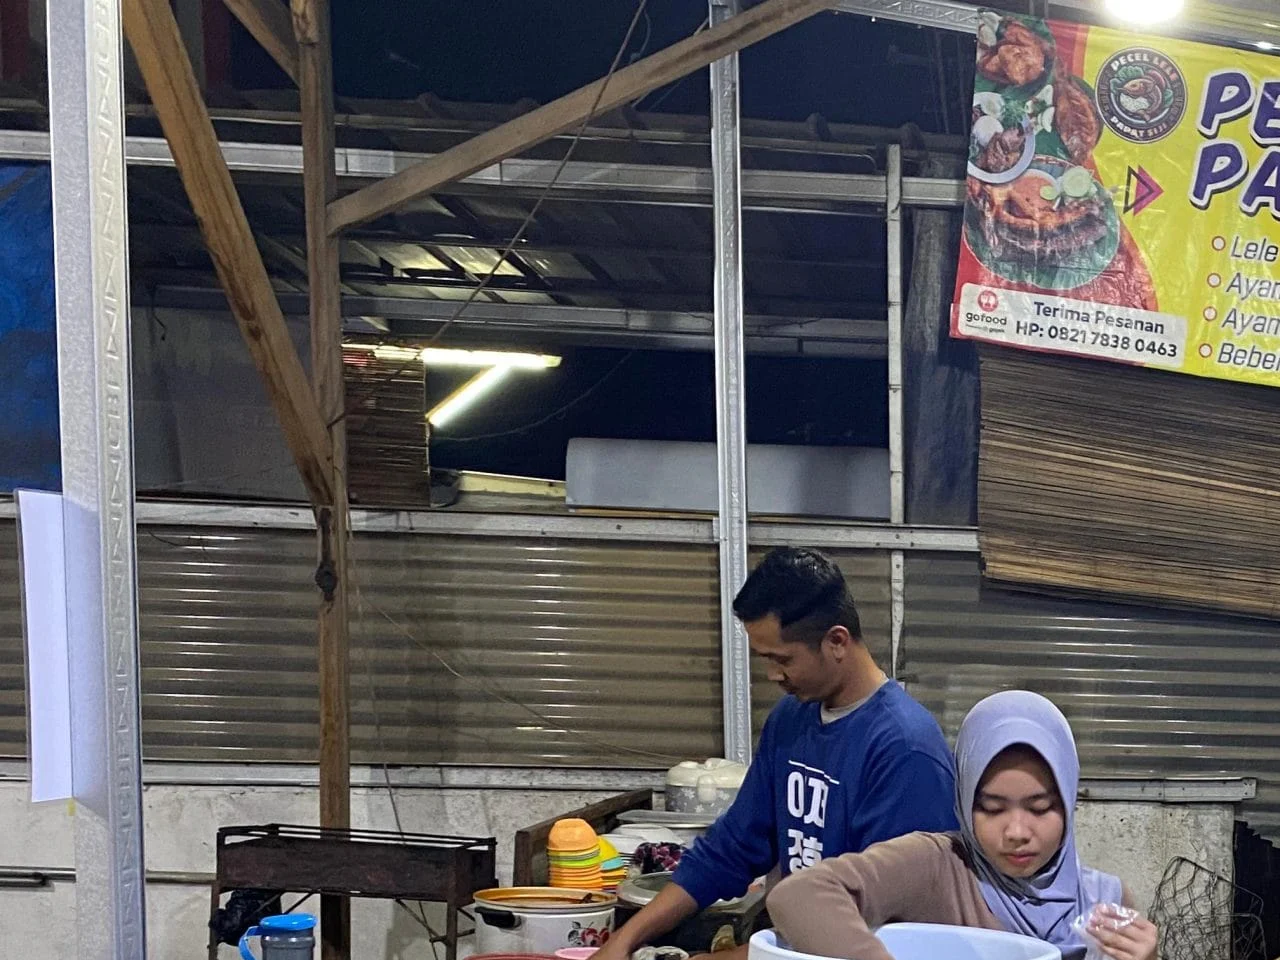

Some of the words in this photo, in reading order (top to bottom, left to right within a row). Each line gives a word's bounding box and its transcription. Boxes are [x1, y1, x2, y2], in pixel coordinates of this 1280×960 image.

[1110, 53, 1150, 71] PECEL
[1110, 115, 1144, 138] PAPAT
[1230, 236, 1280, 265] Lele
[965, 311, 1007, 326] gofood
[1034, 301, 1090, 324] Terima
[1095, 310, 1165, 334] Pesanan
[1016, 321, 1043, 338] HP:
[1048, 325, 1086, 343] 0821
[1091, 331, 1130, 350] 7838
[1135, 339, 1177, 358] 0463
